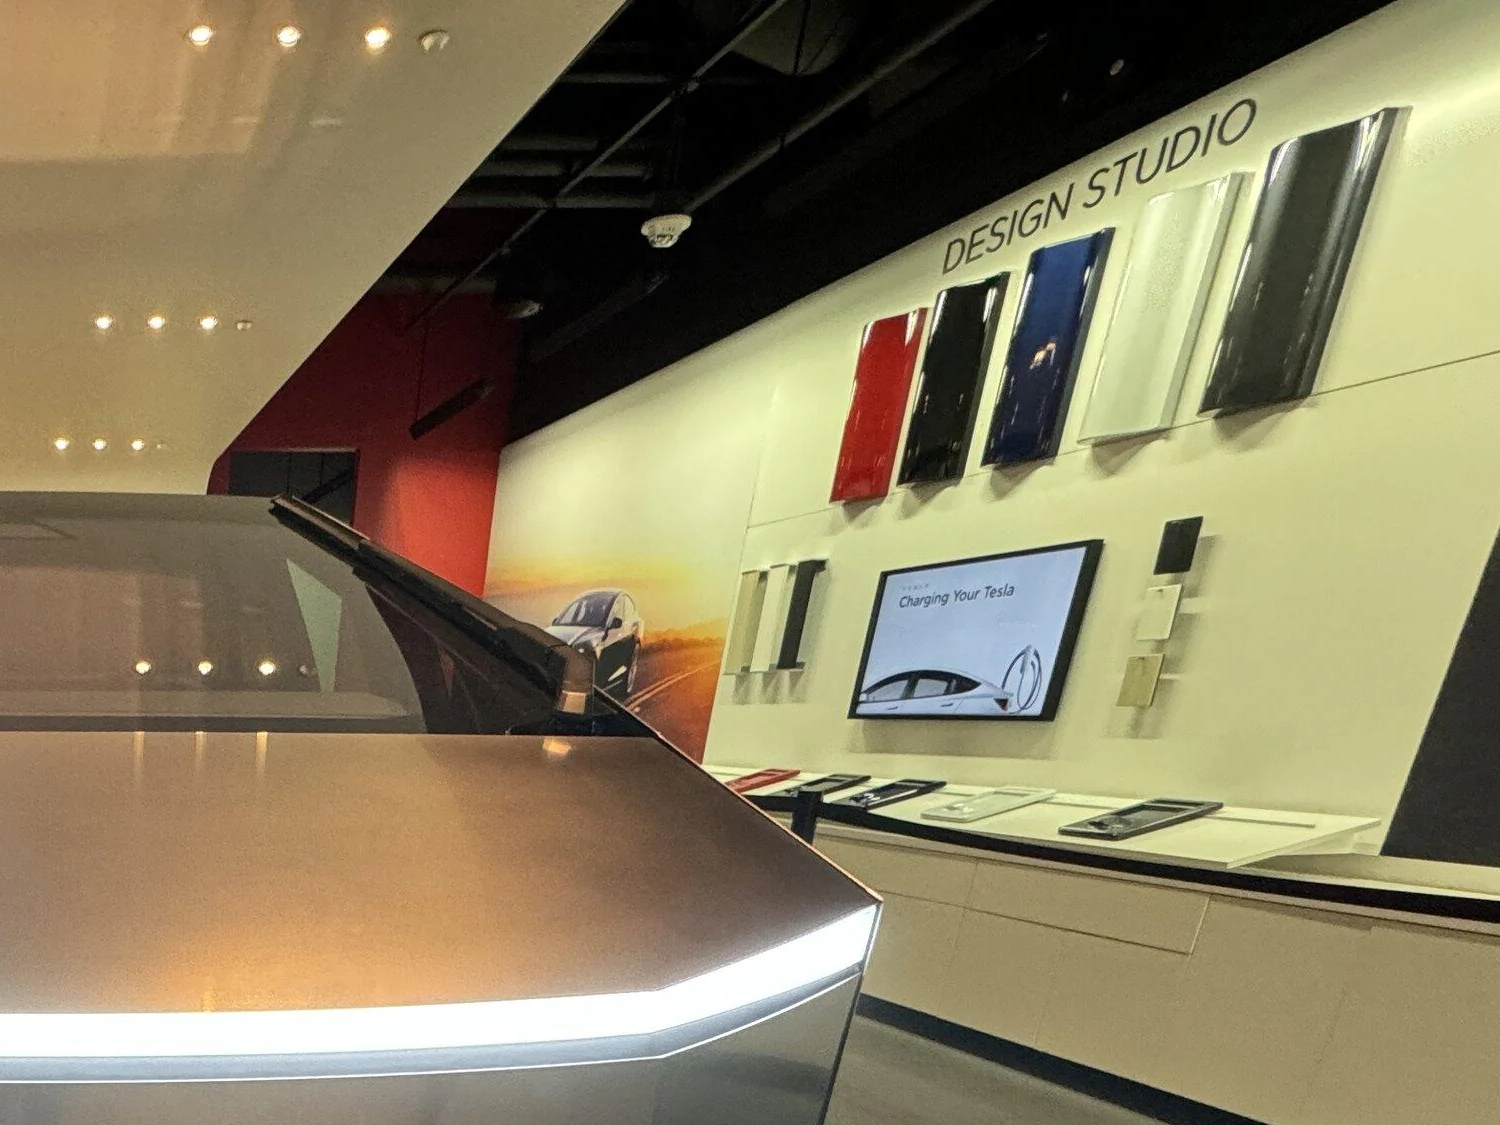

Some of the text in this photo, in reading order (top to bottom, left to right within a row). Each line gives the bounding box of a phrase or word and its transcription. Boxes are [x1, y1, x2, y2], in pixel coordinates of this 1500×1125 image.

[942, 98, 1257, 275] DESIGN STUDIO
[899, 583, 1015, 608] Charging Your Tesla
